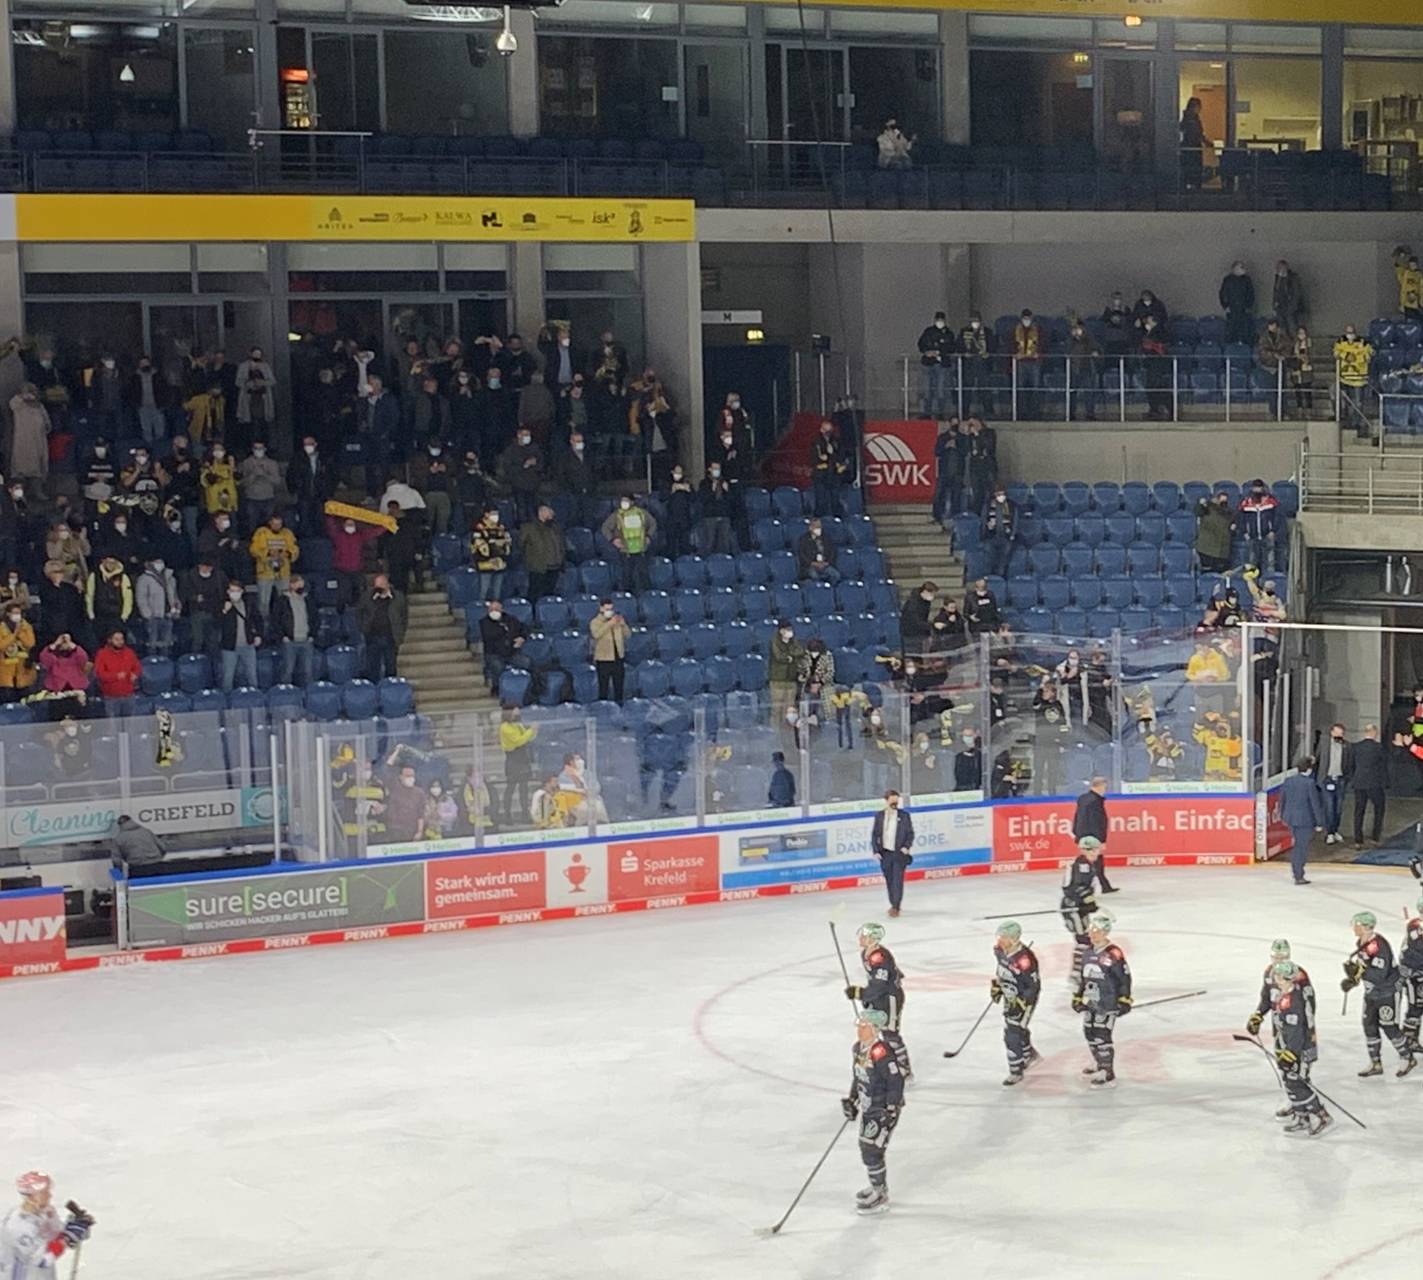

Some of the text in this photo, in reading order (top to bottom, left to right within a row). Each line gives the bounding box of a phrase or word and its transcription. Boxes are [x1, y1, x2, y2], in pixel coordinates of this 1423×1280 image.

[865, 464, 931, 486] SWK
[10, 802, 236, 842] Cleaning CREFELD
[1008, 813, 1074, 838] Einfa
[1110, 811, 1166, 832] nah.
[1009, 839, 1050, 852] swk.de
[643, 855, 705, 872] Sparkasse
[435, 870, 539, 891] Stark wird man
[643, 873, 687, 887] Krefeld
[185, 877, 348, 918] sure[secure]
[435, 888, 518, 908] gemeinsam.
